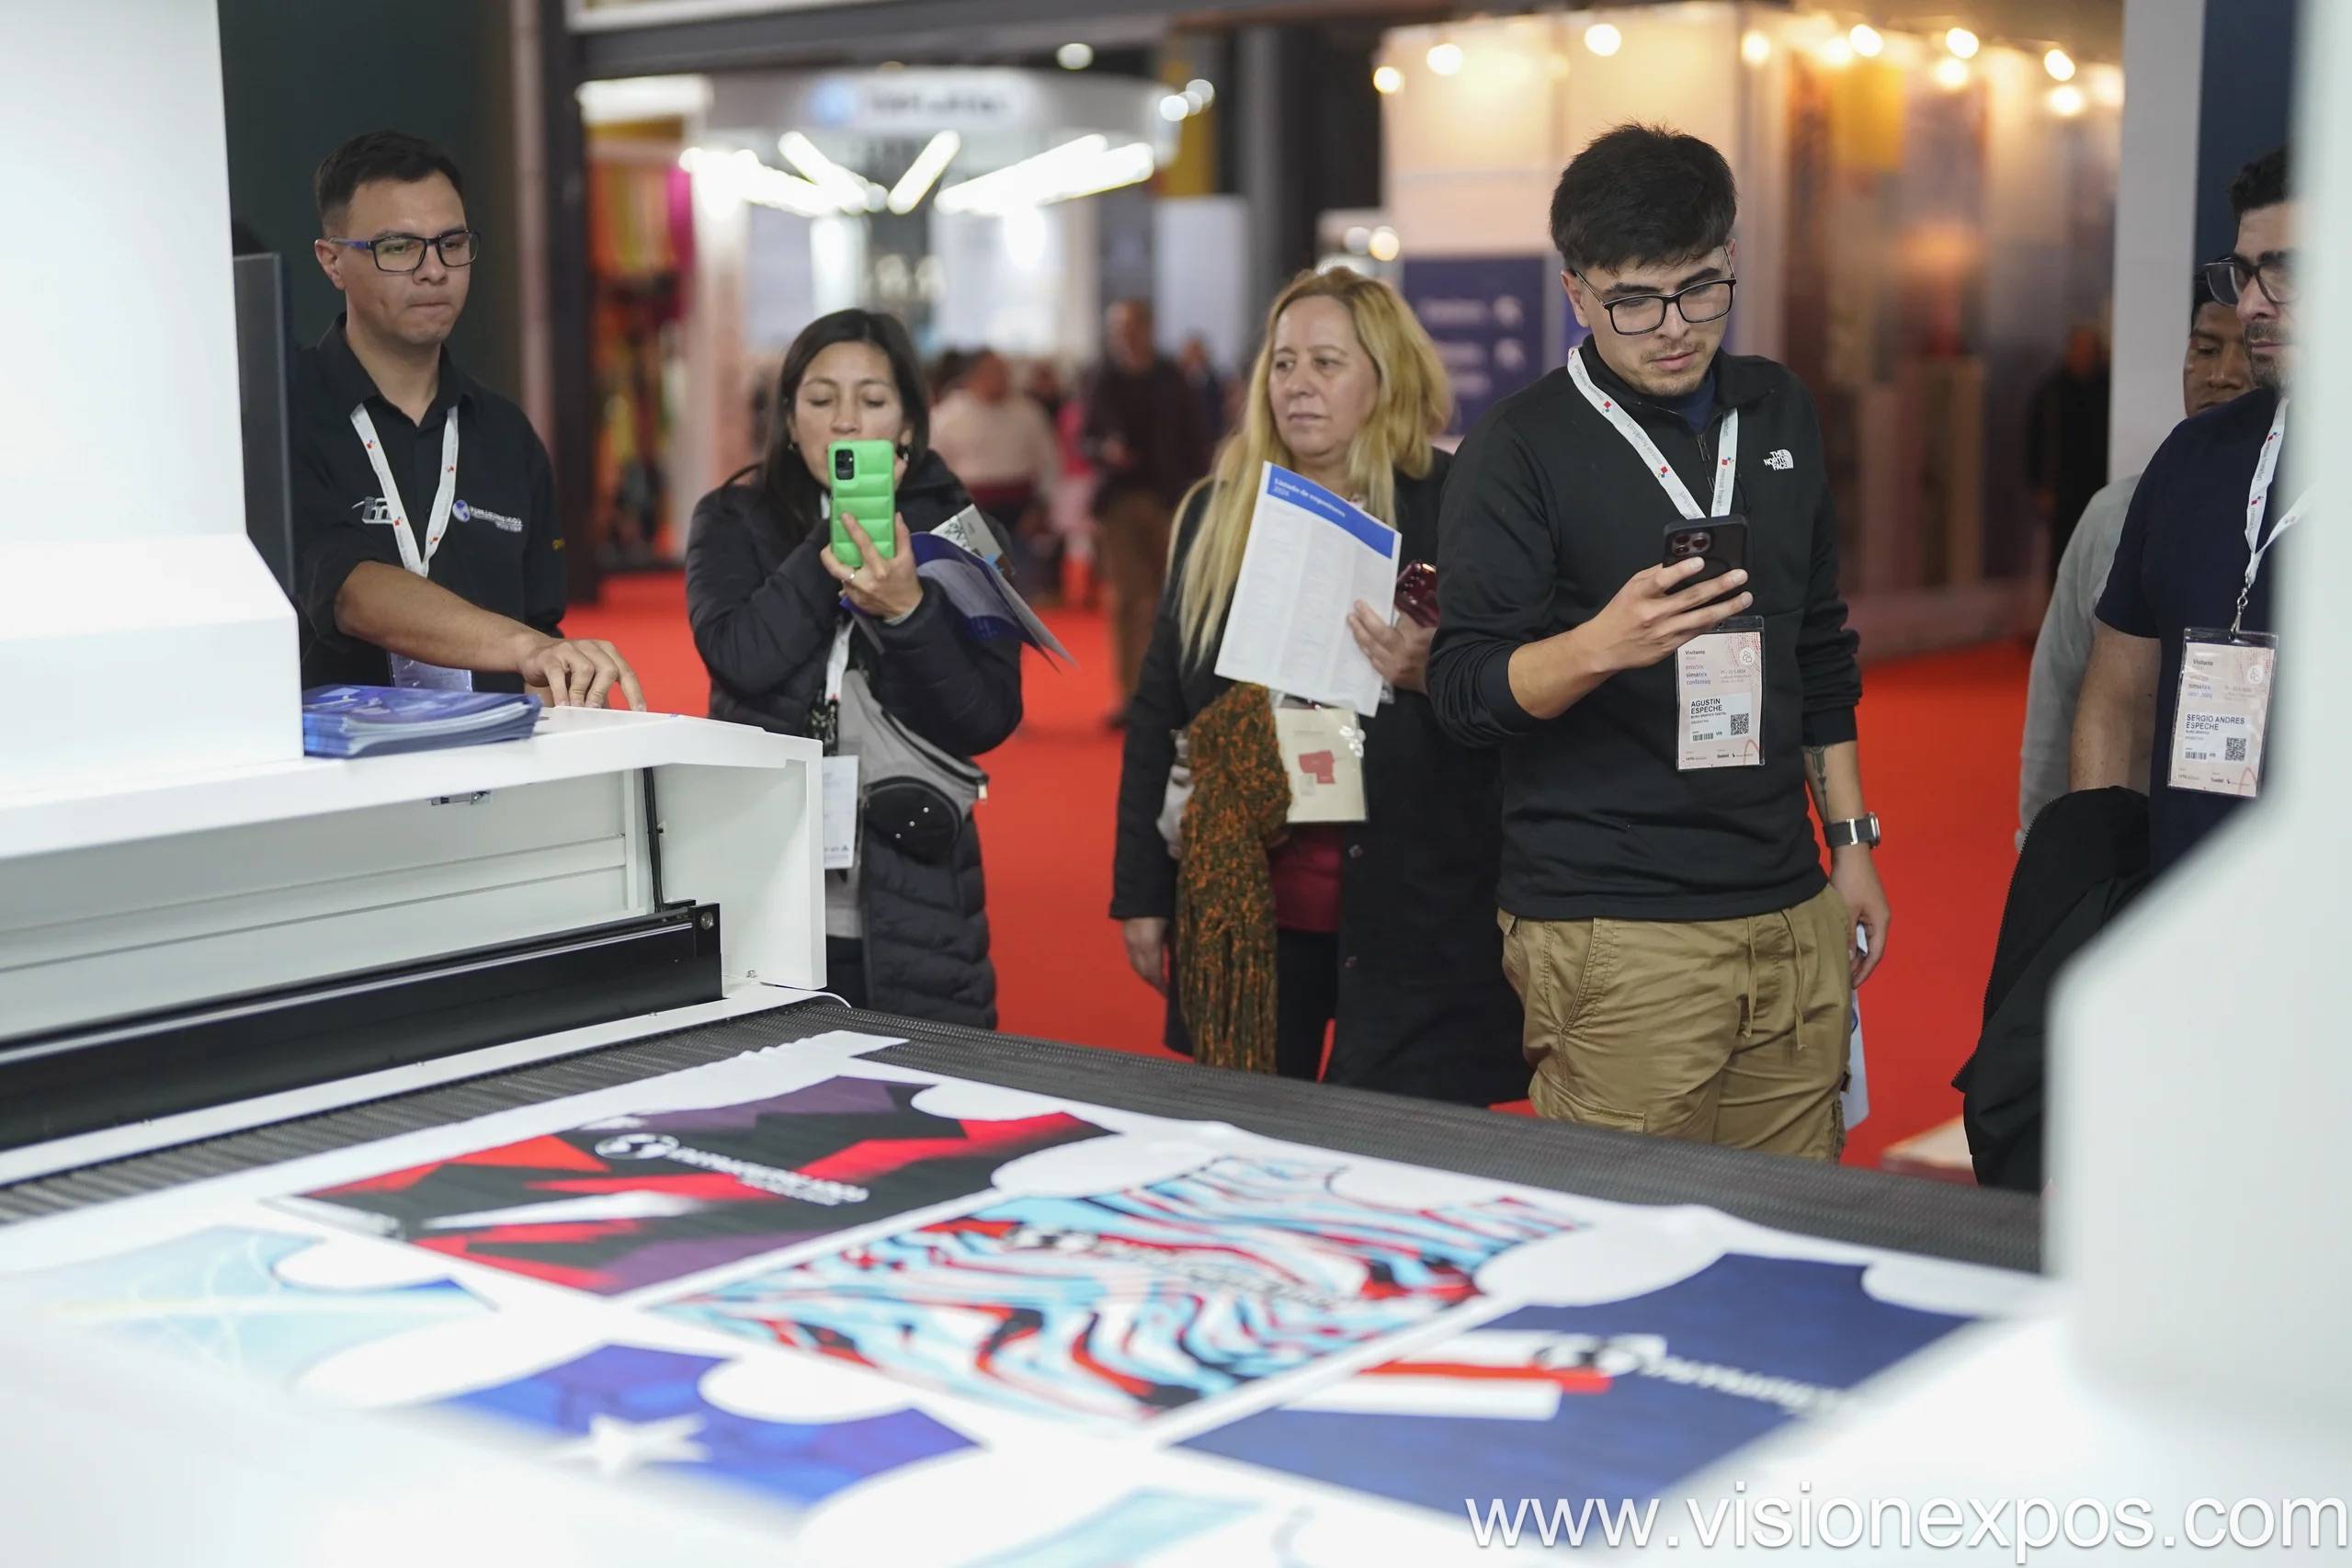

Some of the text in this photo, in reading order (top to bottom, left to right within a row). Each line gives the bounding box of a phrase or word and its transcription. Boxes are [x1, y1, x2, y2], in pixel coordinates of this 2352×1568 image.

[1763, 457, 1786, 466] NORTH
[1300, 488, 1310, 497] de
[1691, 699, 1721, 708] AGUSTIN
[1690, 705, 1723, 714] ESPECHE
[2187, 714, 2244, 724] SERGIO ANDRES
[2186, 722, 2220, 731] ESPECHE
